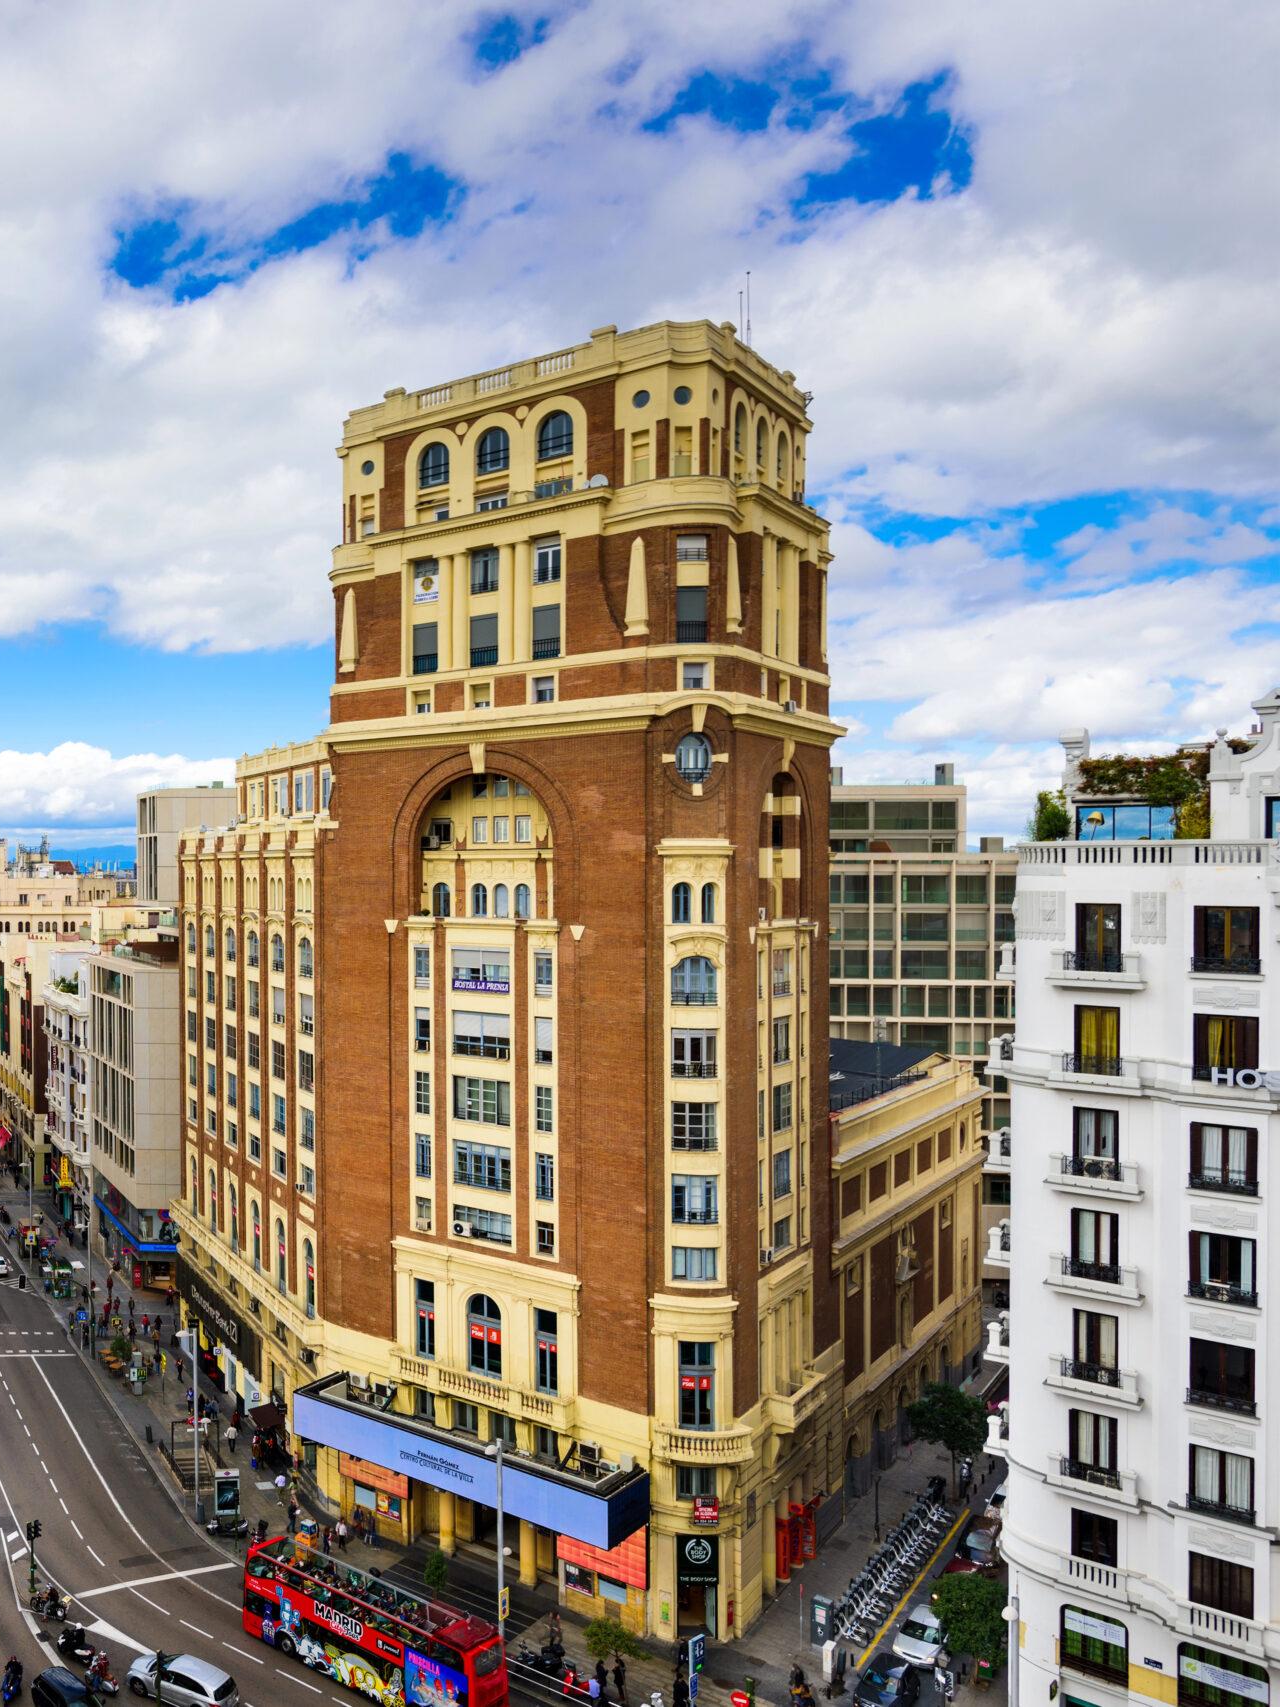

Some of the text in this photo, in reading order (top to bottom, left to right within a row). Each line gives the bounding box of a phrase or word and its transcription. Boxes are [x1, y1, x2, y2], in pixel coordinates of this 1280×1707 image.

[454, 980, 476, 989] HOSTAL
[486, 982, 509, 991] PRENSA
[400, 1452, 418, 1464] CENTRO
[419, 1459, 443, 1473] CULTURAL
[444, 1468, 451, 1476] DE
[457, 1473, 474, 1484] VILLA
[314, 1600, 363, 1637] MADRID
[408, 1651, 441, 1676] PRISCILLA
